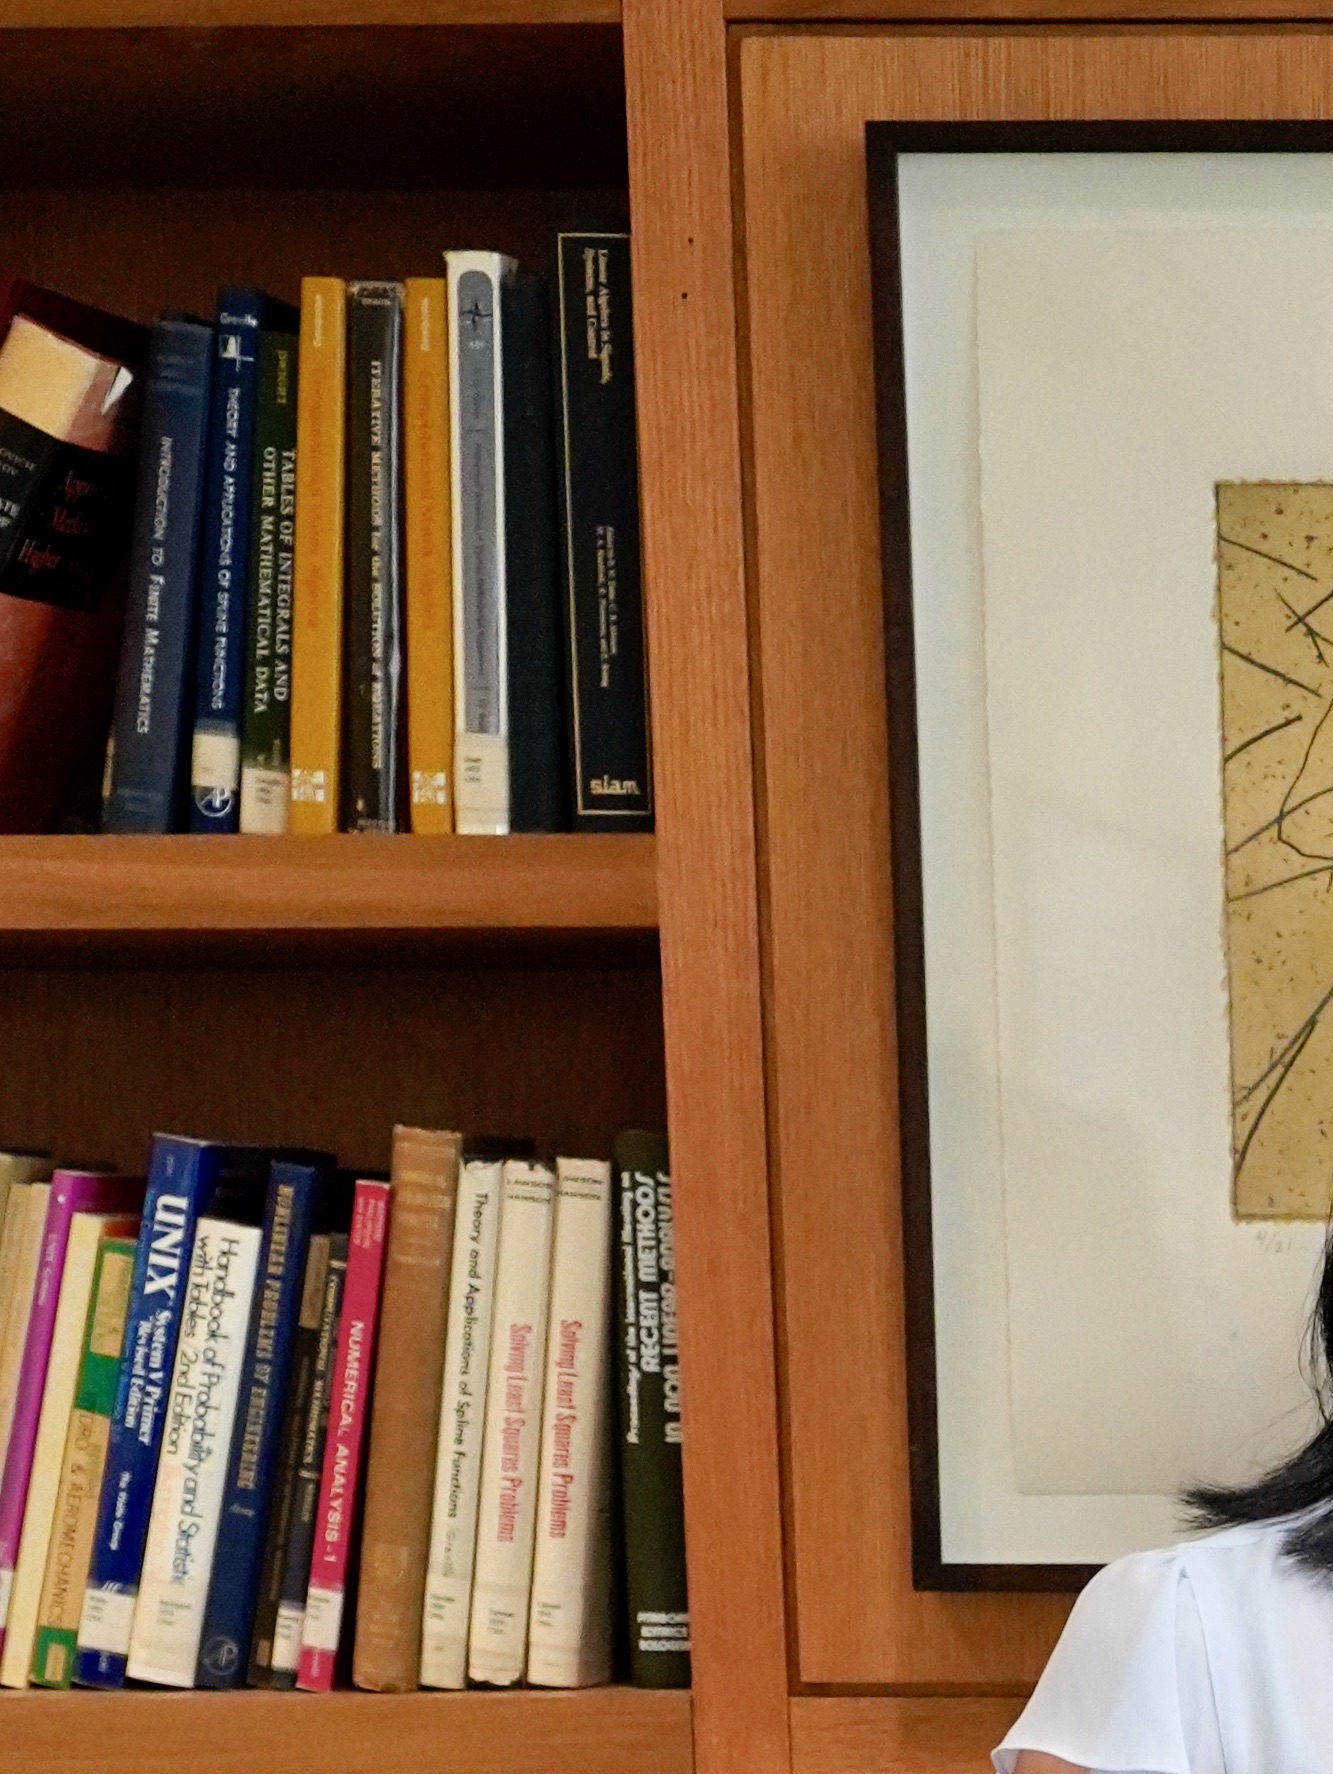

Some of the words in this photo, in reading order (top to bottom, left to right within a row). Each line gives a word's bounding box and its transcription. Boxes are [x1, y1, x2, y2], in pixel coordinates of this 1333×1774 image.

[226, 388, 239, 438] THEORY
[371, 362, 382, 446] ITERATIVE
[223, 442, 236, 471] AND
[261, 447, 276, 508] OTHER
[279, 449, 295, 515] TABLES
[154, 437, 173, 539] INTRODUCTION
[371, 451, 382, 525] METHODS
[219, 475, 235, 566] APPLICATIONS
[279, 521, 294, 546] OF
[152, 548, 164, 565] TO
[218, 570, 231, 588] OF
[215, 592, 229, 633] SPLINE
[255, 515, 274, 658] MATHEMATICAL
[275, 552, 292, 654] INTEGRALS
[211, 636, 227, 710] FUNCTIONS
[254, 666, 269, 714] DATA
[274, 660, 288, 700] AND
[590, 774, 640, 795] siam
[144, 1194, 188, 1294] UNIX
[469, 1192, 488, 1241] Theory
[193, 1235, 212, 1277] with
[468, 1249, 481, 1278] and
[184, 1281, 210, 1338] Tables
[204, 1237, 239, 1341] Handbook
[149, 1309, 172, 1367] System
[256, 1280, 280, 1359] PROBLEMS
[459, 1283, 478, 1376] Applications
[556, 1320, 582, 1368] Solving
[179, 1350, 200, 1389] 2nd
[202, 1348, 224, 1368] of
[504, 1323, 535, 1372] Solving
[338, 1321, 364, 1436] NUMERICAL
[460, 1381, 474, 1397] of
[506, 1376, 529, 1413] Least
[558, 1371, 580, 1409] Least
[139, 1385, 162, 1446] Primer
[166, 1392, 192, 1455] Edition
[184, 1371, 220, 1478] Probability
[452, 1400, 471, 1445] Spline
[552, 1413, 576, 1468] Squares
[501, 1417, 525, 1472] Squares
[180, 1478, 205, 1518] and
[447, 1451, 466, 1519] Functions
[498, 1477, 522, 1542] Problems
[549, 1474, 574, 1538] Problems
